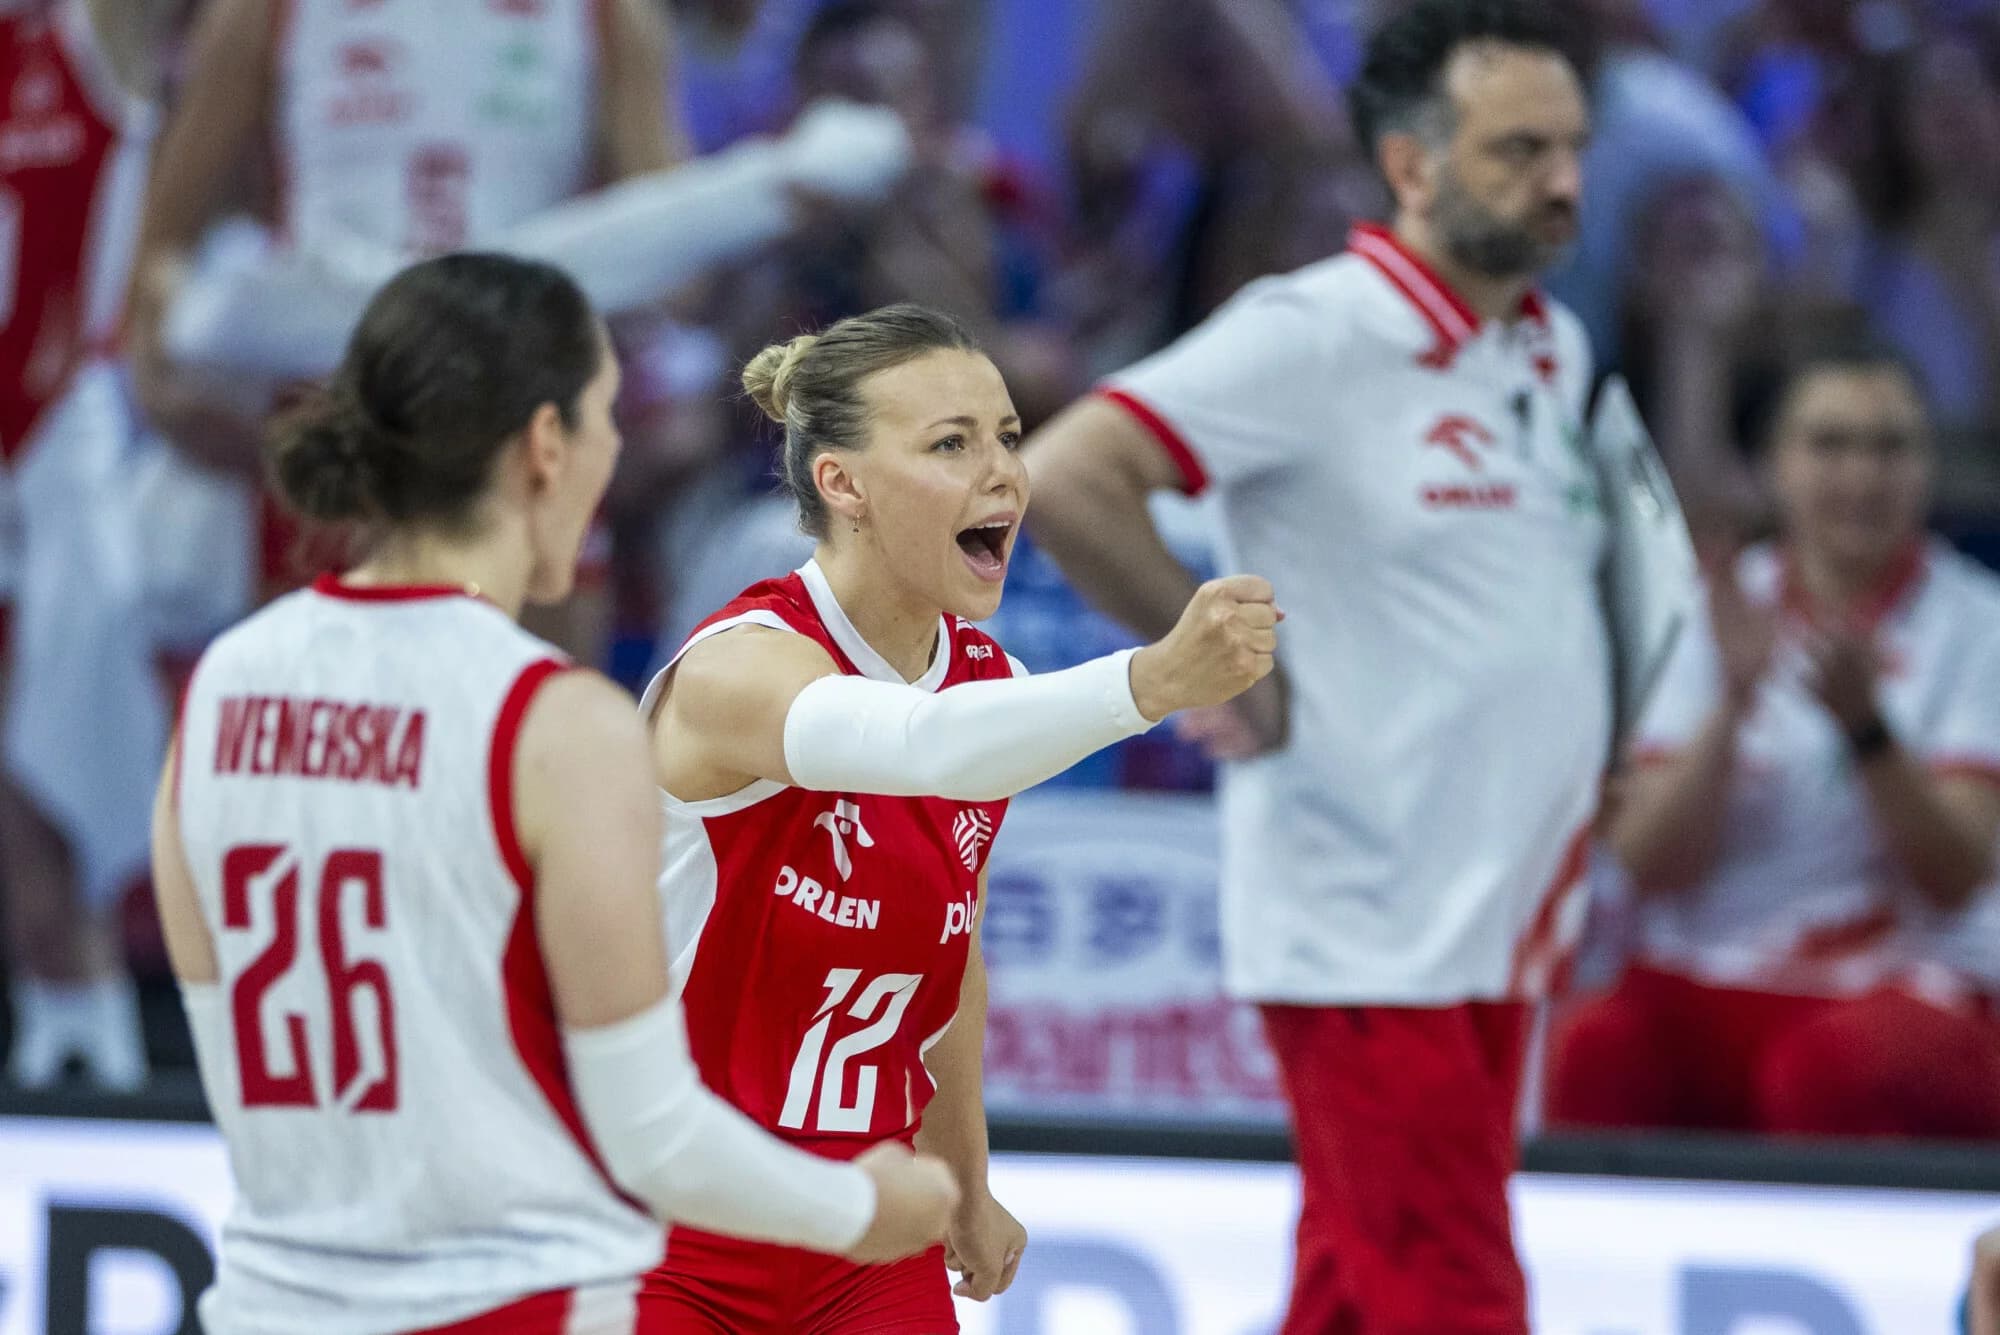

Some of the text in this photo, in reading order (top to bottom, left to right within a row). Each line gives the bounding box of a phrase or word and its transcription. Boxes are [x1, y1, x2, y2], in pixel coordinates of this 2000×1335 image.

[965, 644, 994, 661] OREN
[774, 865, 880, 930] ORLEN
[222, 843, 398, 1113] 26
[777, 967, 924, 1133] 12
